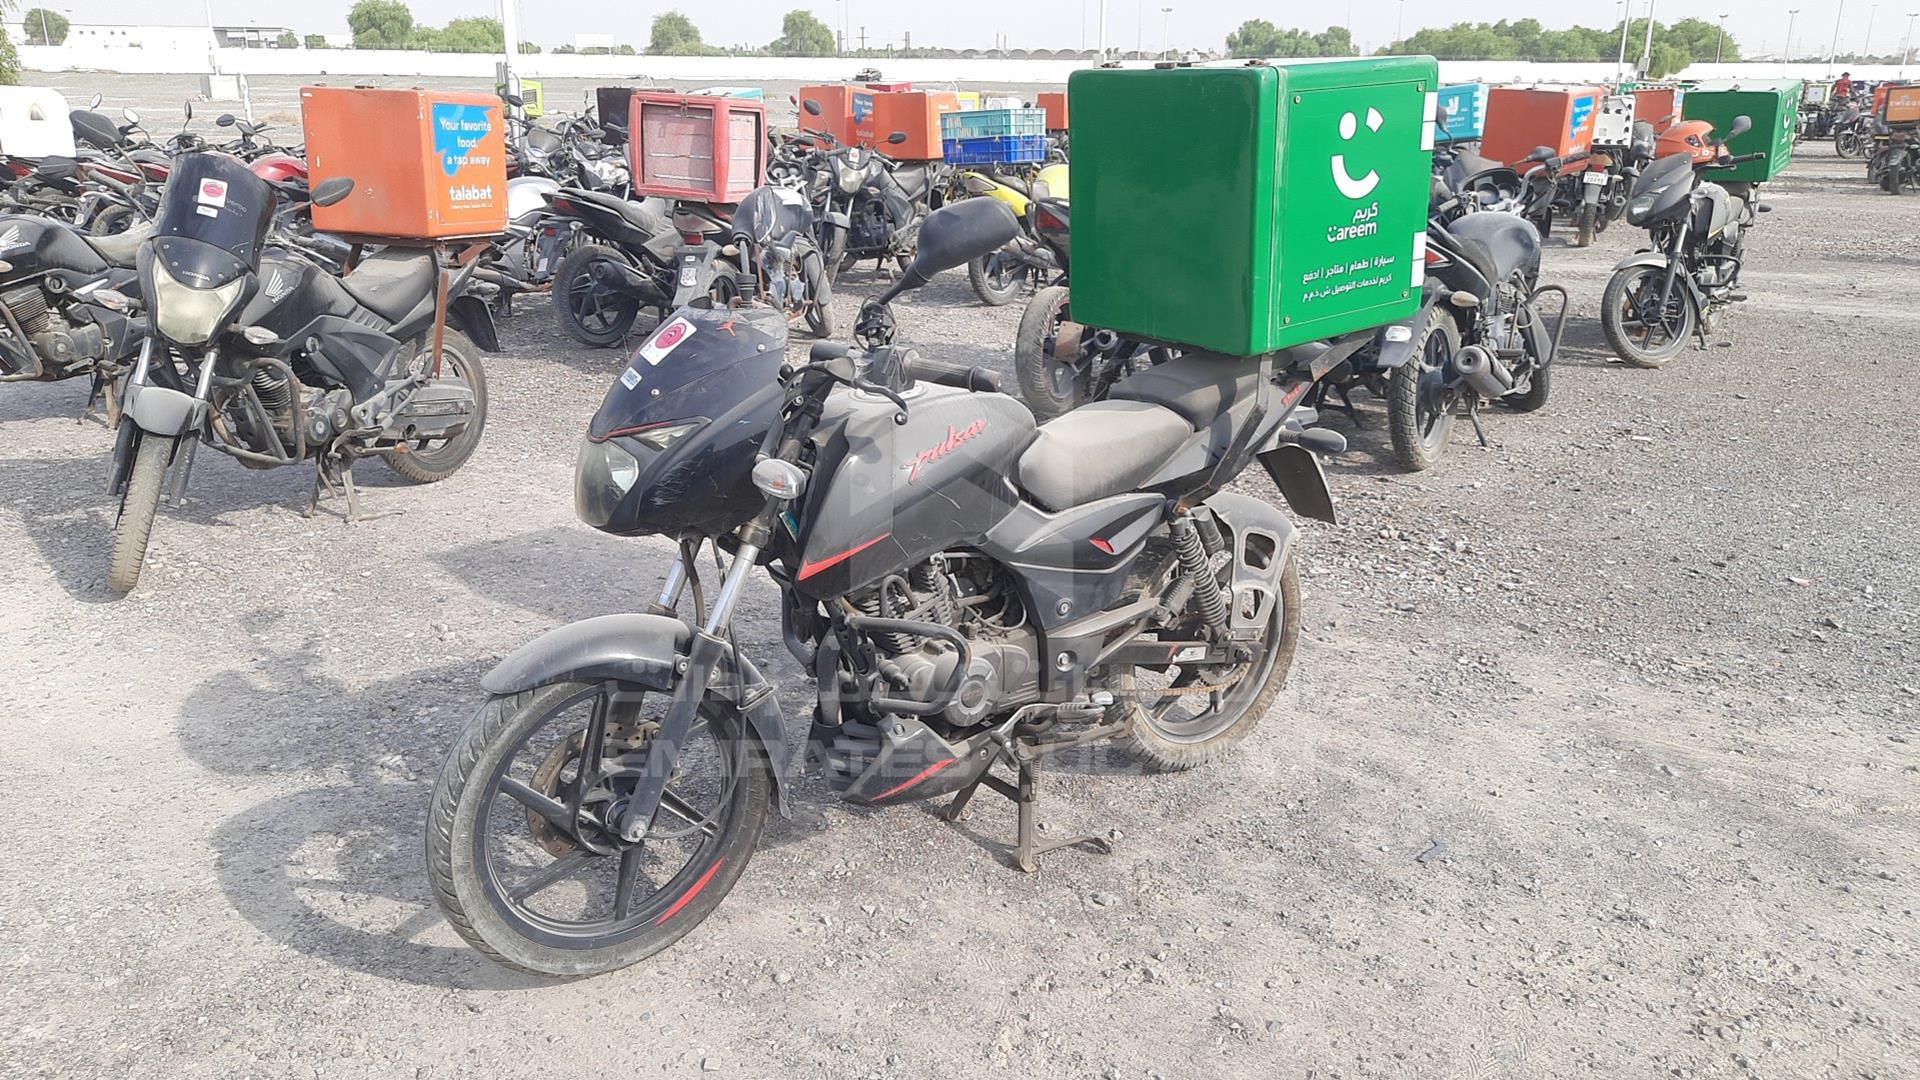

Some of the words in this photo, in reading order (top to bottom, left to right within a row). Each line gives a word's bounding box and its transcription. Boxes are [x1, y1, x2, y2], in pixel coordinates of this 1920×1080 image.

[439, 118, 459, 131] Your
[461, 119, 492, 132] favorite
[454, 155, 469, 168] tap
[470, 157, 490, 168] away
[449, 184, 493, 201] talabat
[1352, 201, 1378, 224] كريم
[1327, 222, 1377, 243] Careem
[1349, 260, 1369, 275] طعام
[1374, 255, 1395, 268] سيارة
[182, 270, 211, 281] HONDA
[1302, 270, 1320, 285] ادفع
[1325, 264, 1344, 279] متاجر
[1357, 276, 1378, 288] لخدمات
[1378, 273, 1393, 286] كريم
[1331, 280, 1356, 295] التوصيل
